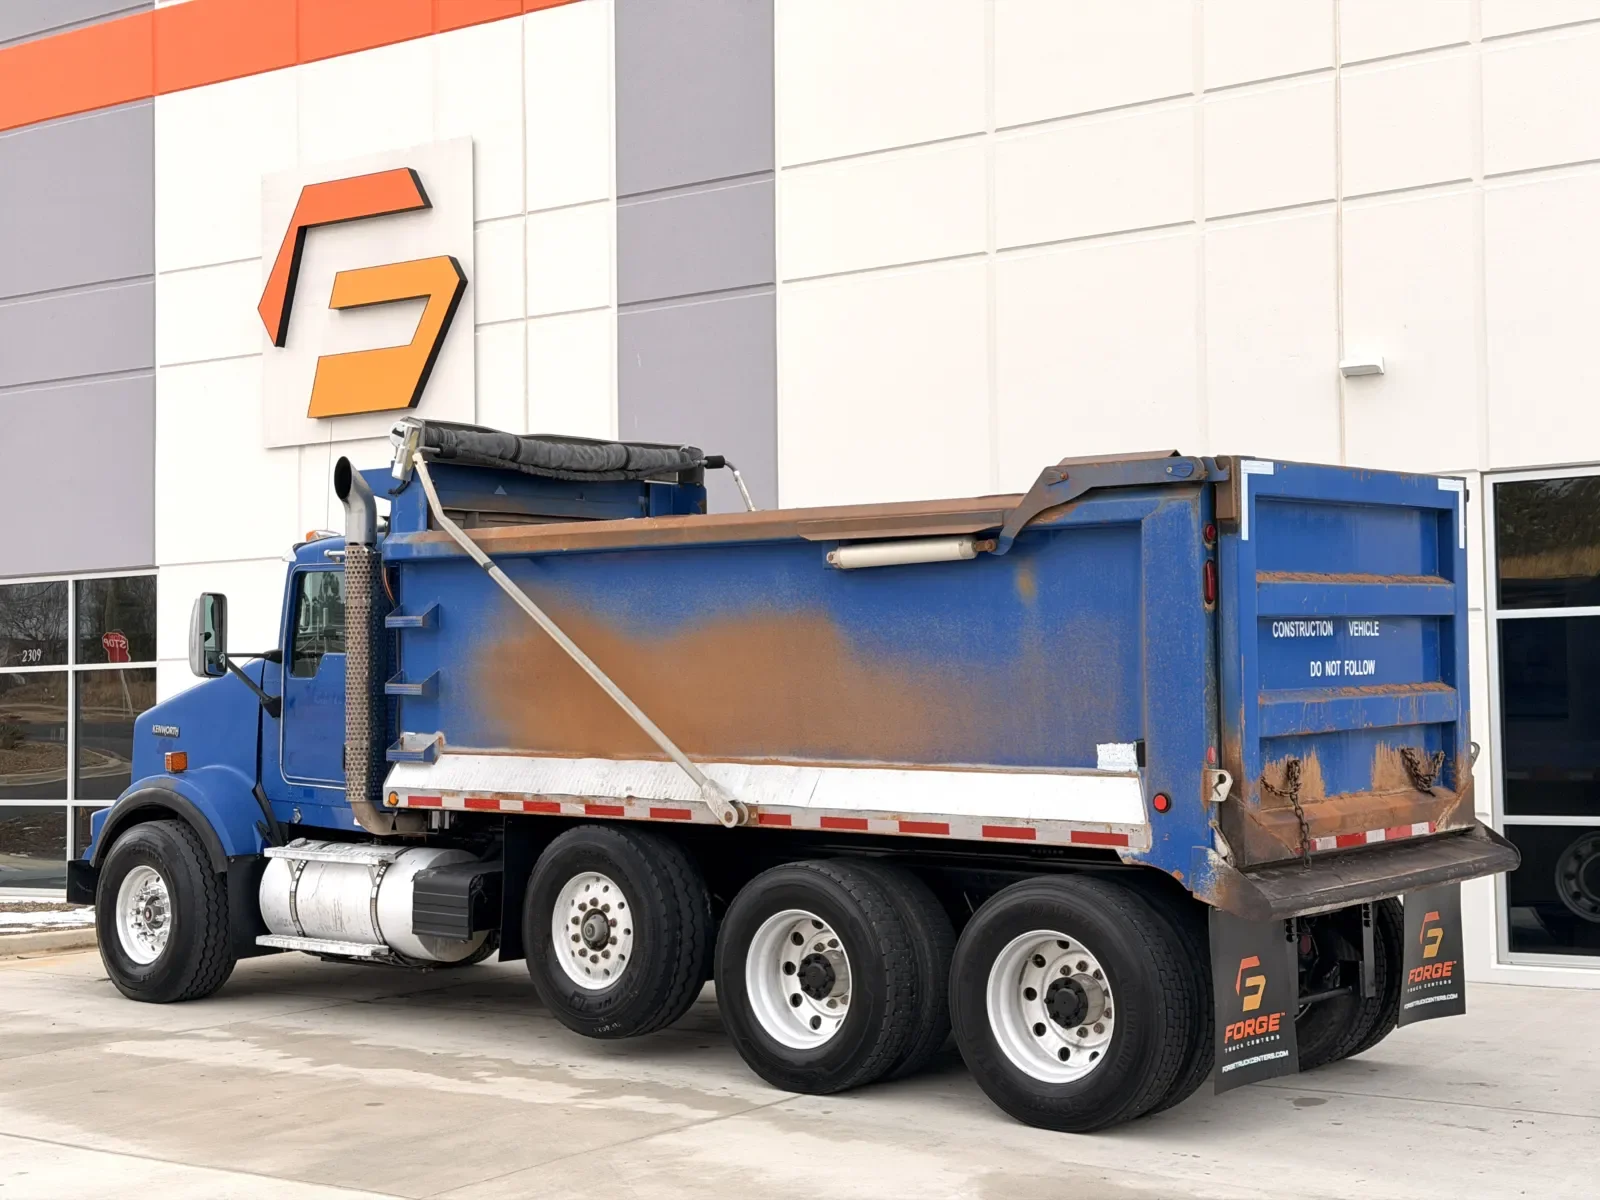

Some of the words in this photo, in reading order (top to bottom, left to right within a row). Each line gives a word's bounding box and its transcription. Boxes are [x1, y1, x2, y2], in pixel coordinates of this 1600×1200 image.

[1272, 621, 1333, 637] CONSTRUCTION
[1348, 621, 1380, 637] VEHICLE
[21, 648, 42, 662] 2309
[1310, 661, 1322, 677] DO
[1325, 660, 1341, 676] NOT
[1344, 659, 1376, 676] FOLLOW
[1407, 961, 1453, 985] FORGE
[1224, 1012, 1281, 1044] FORGE
